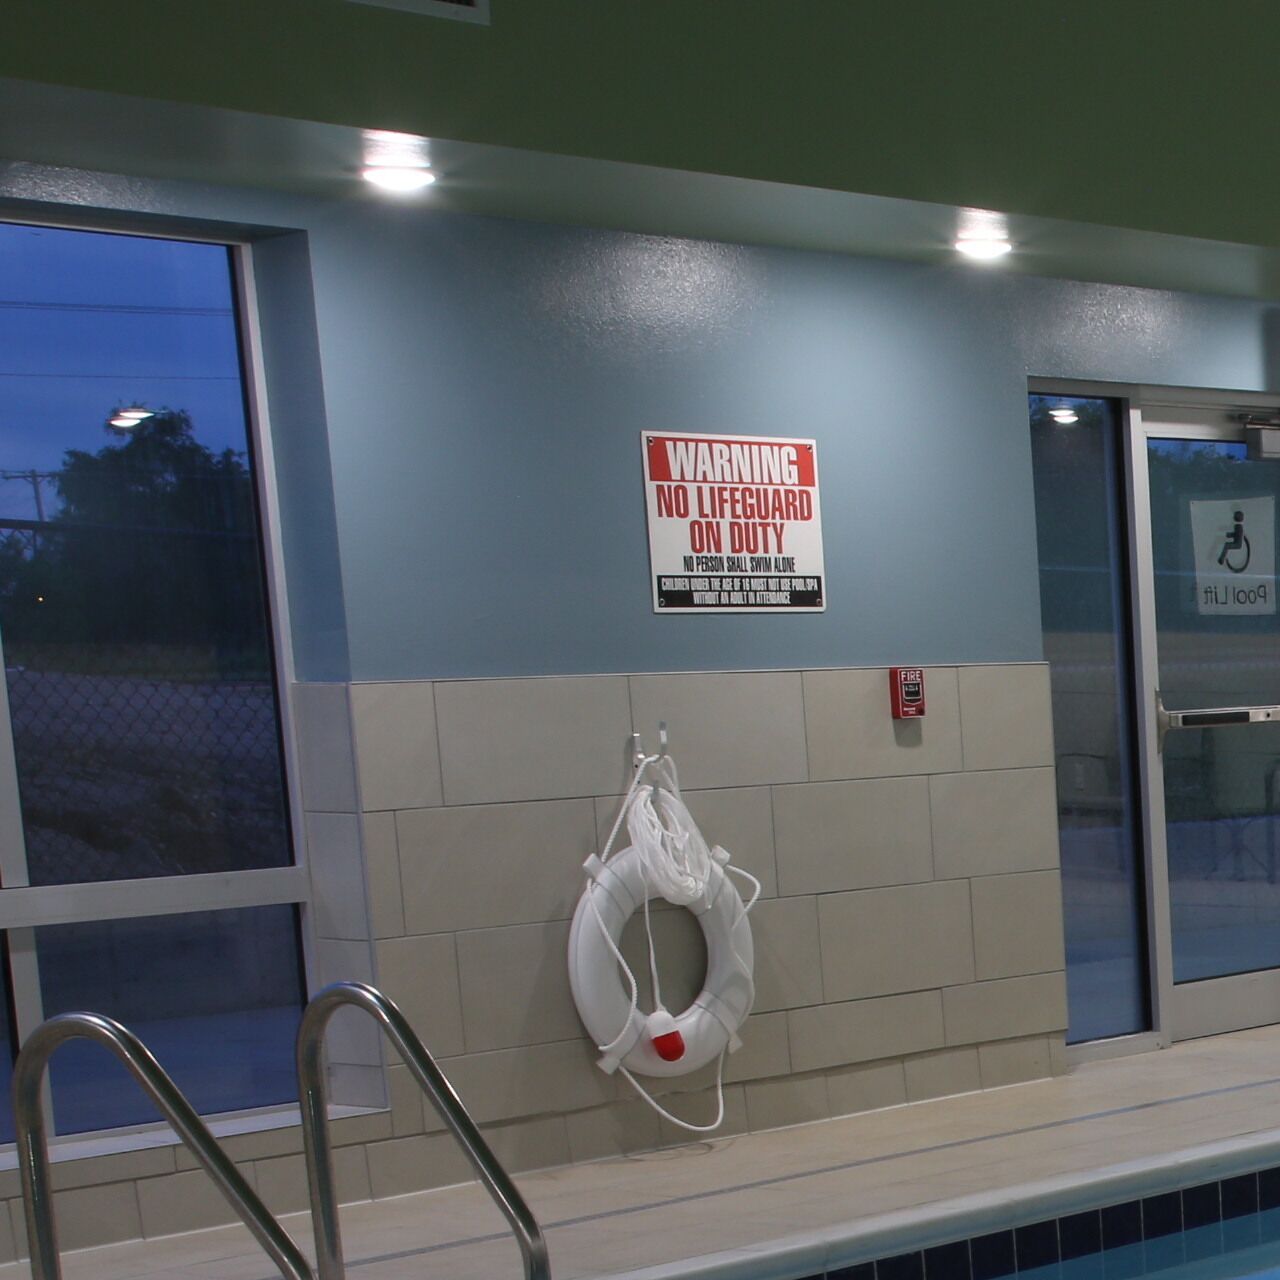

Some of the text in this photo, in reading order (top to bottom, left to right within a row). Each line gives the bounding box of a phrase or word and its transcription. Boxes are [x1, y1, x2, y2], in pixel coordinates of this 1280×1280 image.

[665, 440, 799, 486] WARNING
[656, 484, 813, 521] NO LIFEGUARD
[689, 520, 785, 555] ON DUTY
[683, 555, 796, 573] NO PERSON SHALL SWIM ALONE
[661, 577, 690, 591] CHILDREN
[901, 671, 921, 681] FIRE
